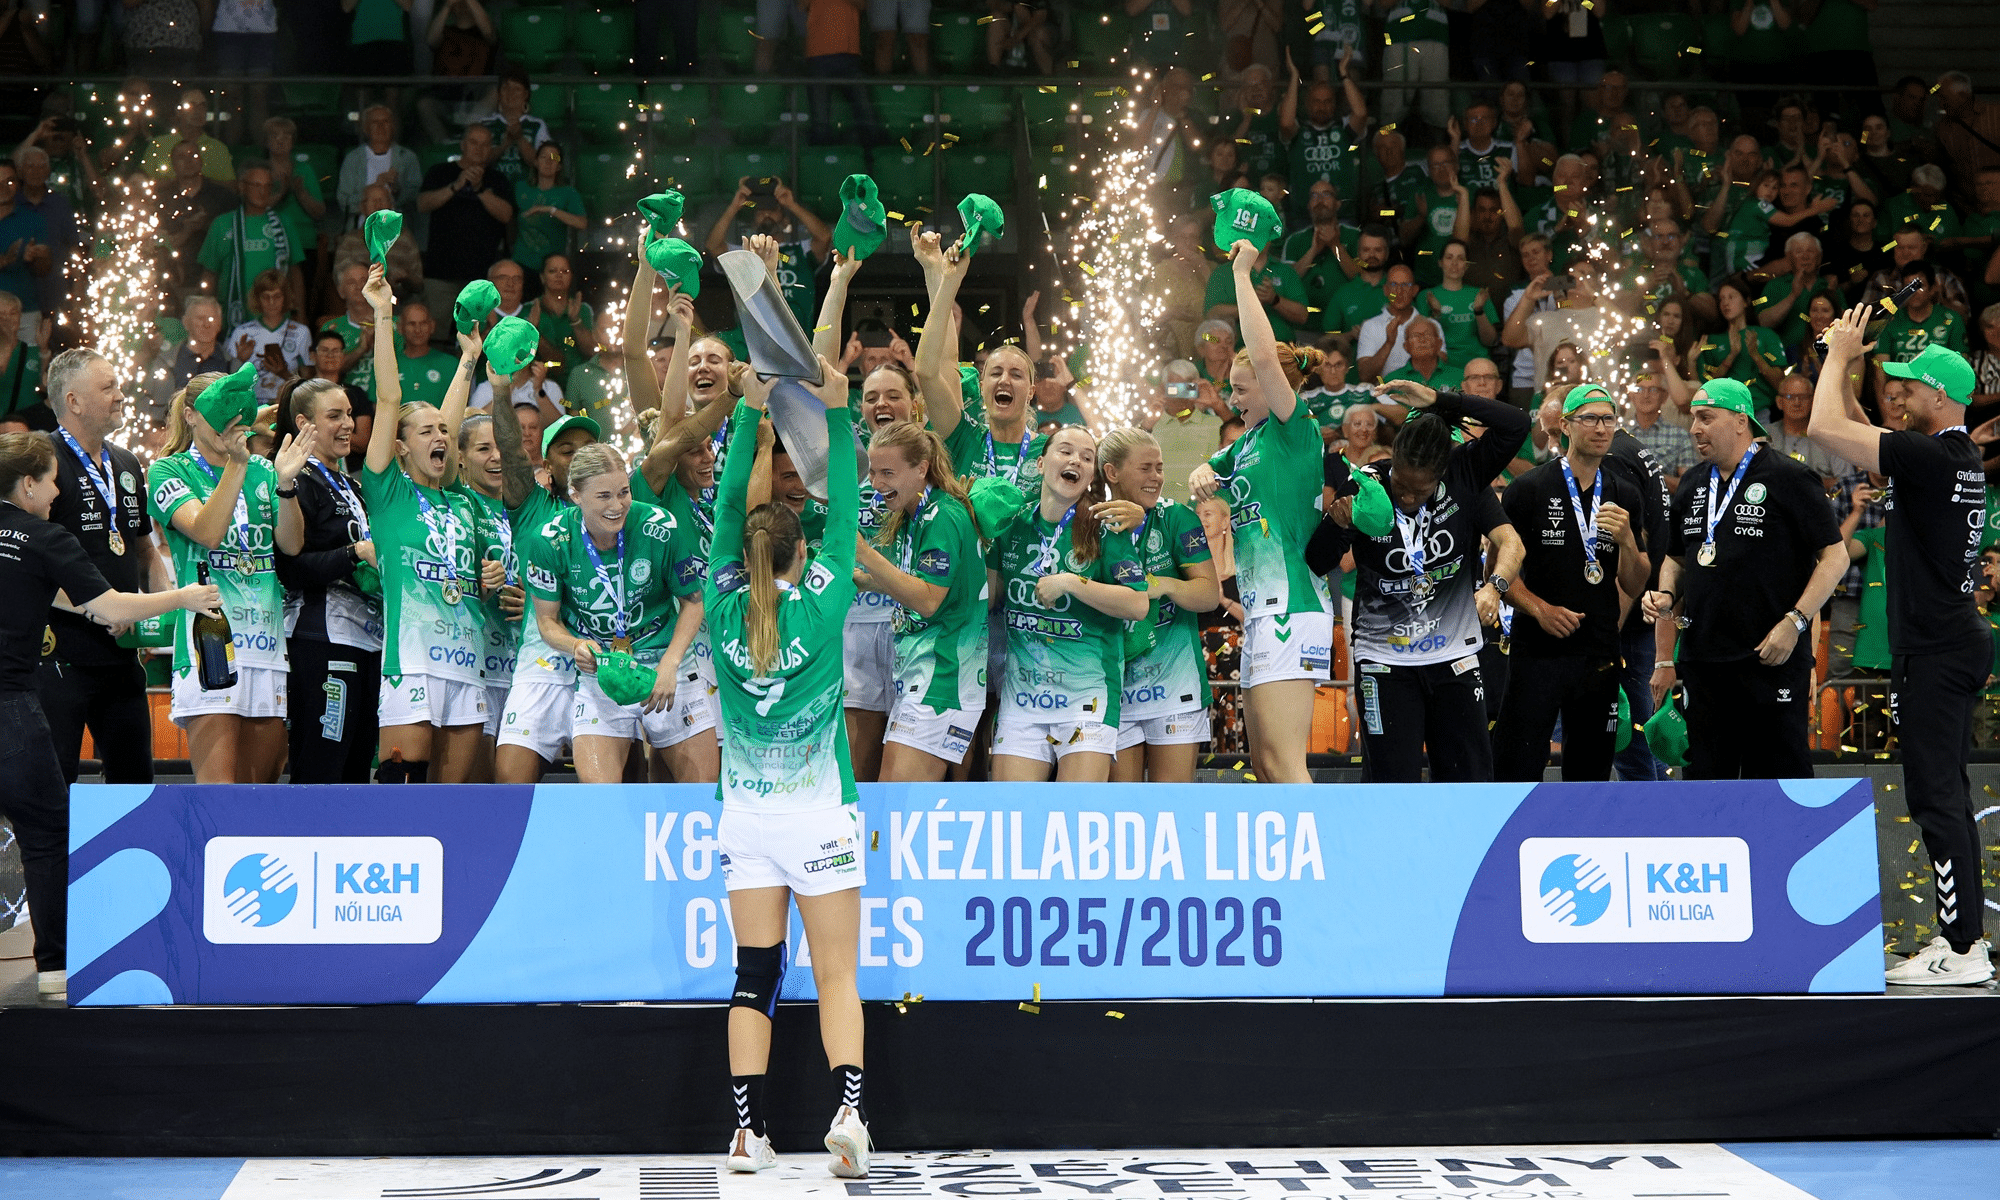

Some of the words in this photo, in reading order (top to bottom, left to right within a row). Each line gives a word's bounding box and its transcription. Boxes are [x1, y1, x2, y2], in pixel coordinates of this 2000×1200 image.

[12, 531, 29, 543] KC
[1734, 526, 1764, 538] GYŐR
[231, 631, 278, 652] GYŐR
[428, 646, 477, 669] GYŐR
[409, 686, 426, 702] 23
[1016, 690, 1068, 709] GYŐR
[1121, 685, 1167, 705] YŐR
[505, 712, 517, 726] 10
[575, 704, 585, 719] 21
[889, 797, 1185, 881] KÉZILABDA
[1205, 811, 1326, 881] LIGA
[335, 863, 419, 894] K&H
[1646, 863, 1729, 894] K&H
[335, 901, 362, 922] NŐI
[367, 904, 403, 922] LIGA
[1648, 901, 1675, 921] NŐI
[1680, 904, 1715, 921] LIGA
[965, 895, 1283, 968] 2025/2026
[868, 1155, 1682, 1179] SZÉCHENYI
